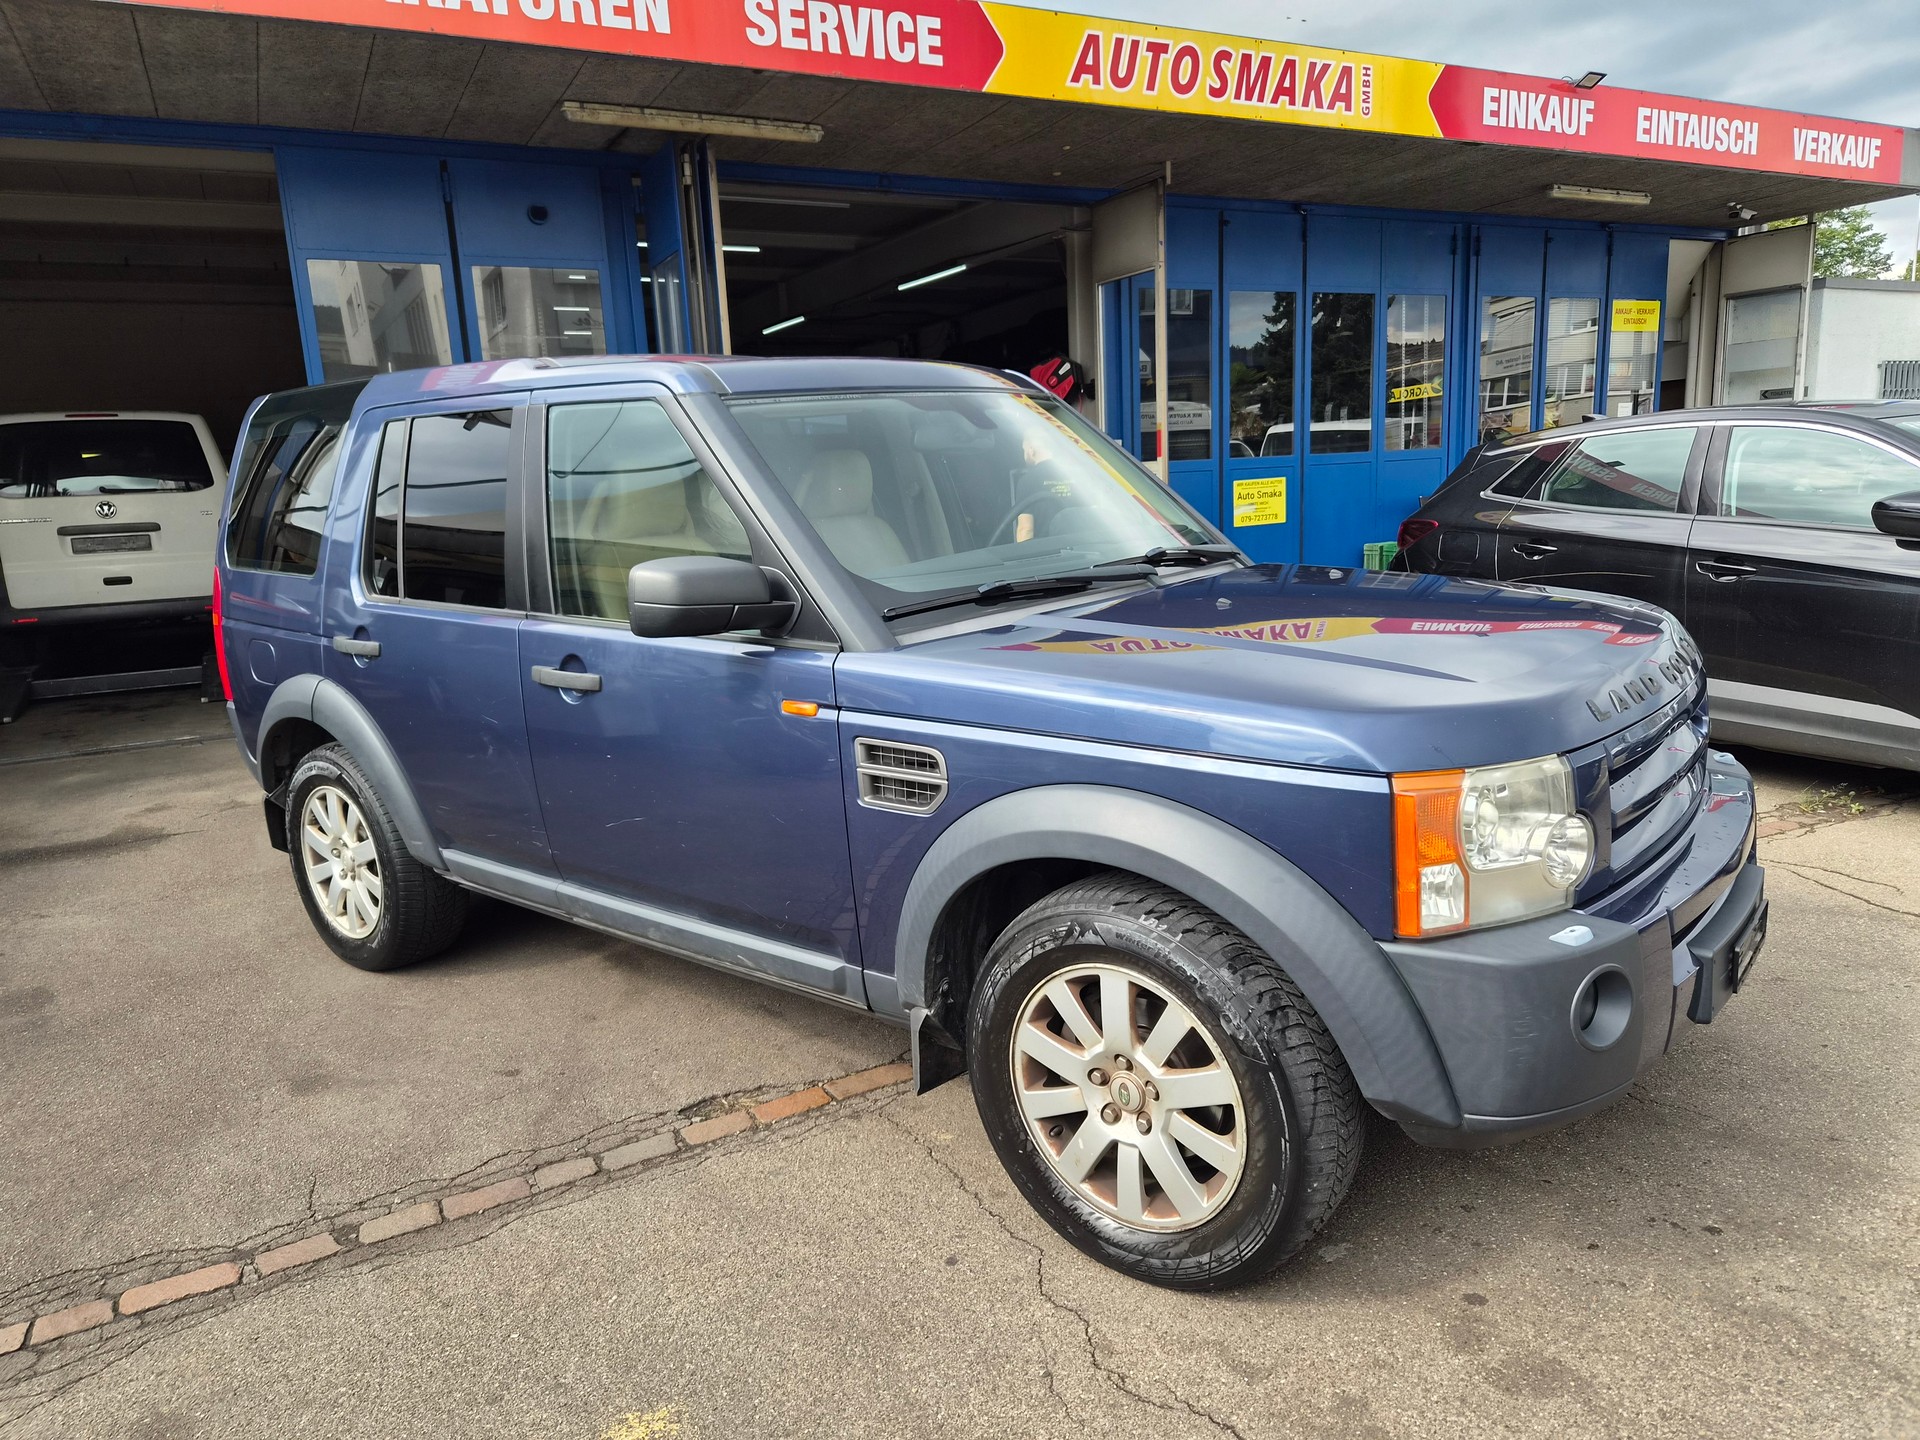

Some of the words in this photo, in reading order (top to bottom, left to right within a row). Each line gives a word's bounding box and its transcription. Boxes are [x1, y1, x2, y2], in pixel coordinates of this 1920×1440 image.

[744, 0, 944, 67] SERVICE
[1069, 33, 1201, 97] AUTO
[1206, 47, 1355, 114] SMAKA
[1360, 65, 1372, 117] GMBH
[1482, 86, 1595, 136] EINKAUF
[1636, 107, 1758, 156] EINTAUSCH
[1793, 127, 1882, 169] VERKAUF
[1623, 317, 1647, 325] EINTAUSCH
[1237, 492, 1255, 500] Auto
[1256, 489, 1282, 499] Smaka
[1585, 672, 1662, 723] LAND
